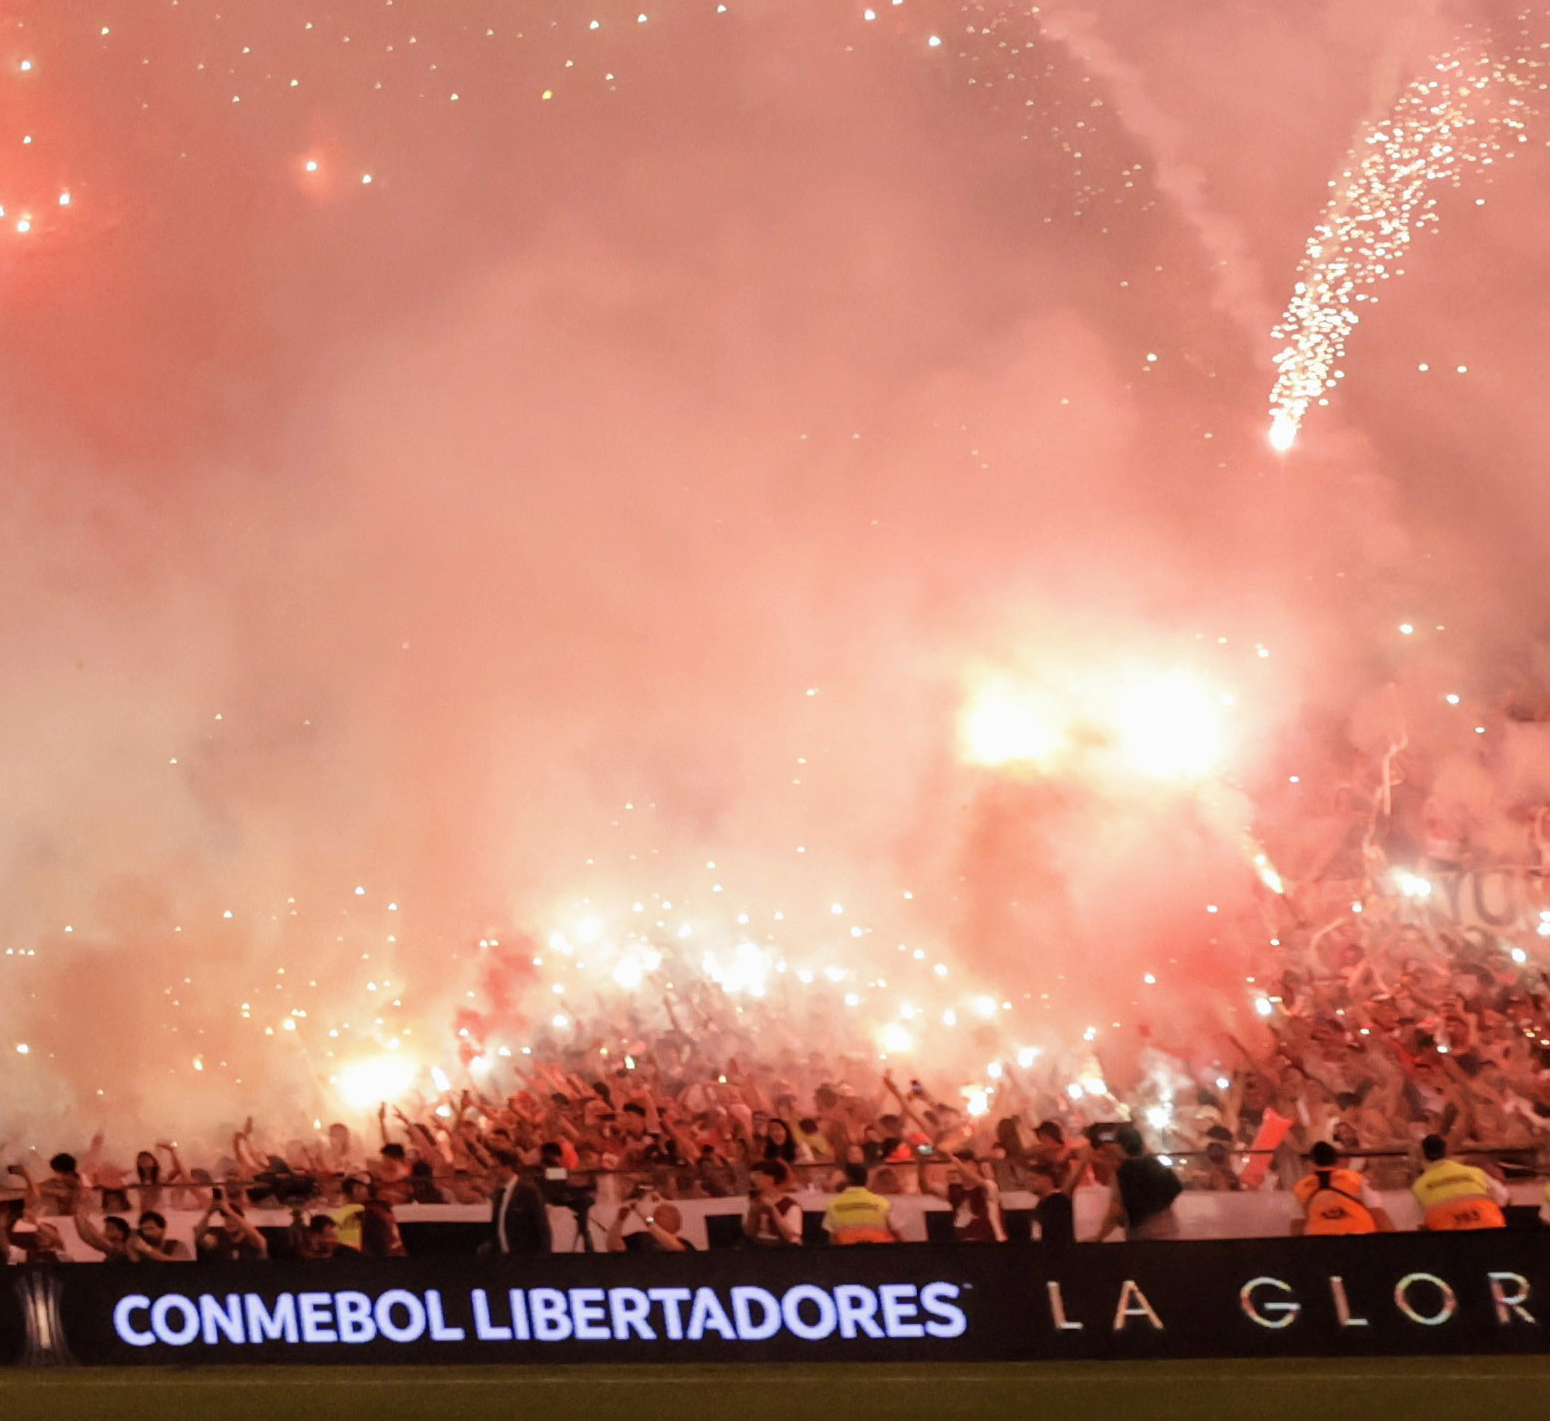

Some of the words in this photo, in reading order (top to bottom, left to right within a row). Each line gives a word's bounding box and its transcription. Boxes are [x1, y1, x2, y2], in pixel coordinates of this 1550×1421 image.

[113, 1289, 466, 1346] CONMEBOL
[471, 1281, 968, 1342] LIBERTADORES
[1047, 1280, 1164, 1330] LA
